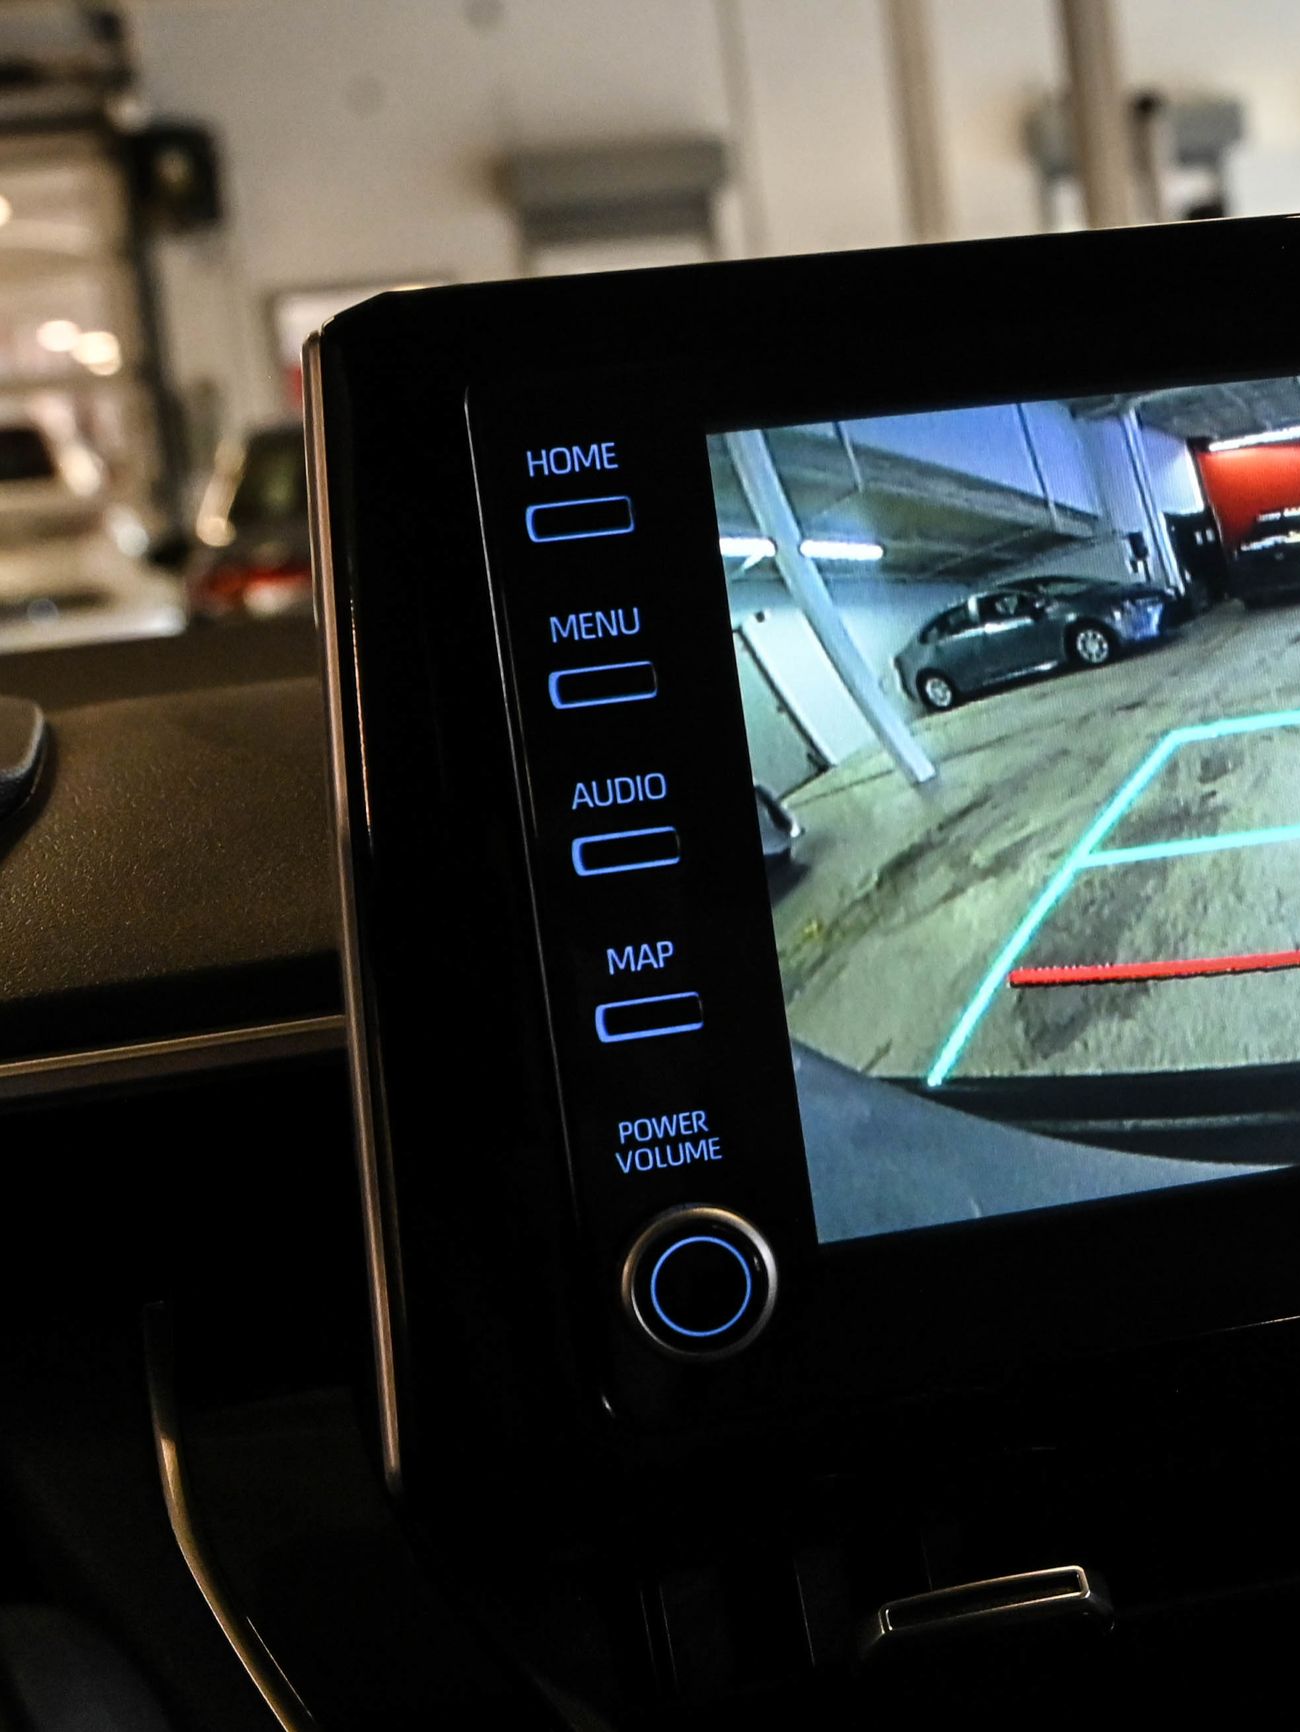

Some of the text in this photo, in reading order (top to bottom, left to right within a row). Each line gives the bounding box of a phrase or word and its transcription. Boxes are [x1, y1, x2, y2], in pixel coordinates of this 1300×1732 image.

[526, 442, 619, 477] HOME
[549, 607, 641, 643] MENU
[571, 773, 667, 810] AUDIO
[606, 940, 674, 975] MAP
[617, 1110, 708, 1144] POWER
[615, 1137, 722, 1174] VOLUME
